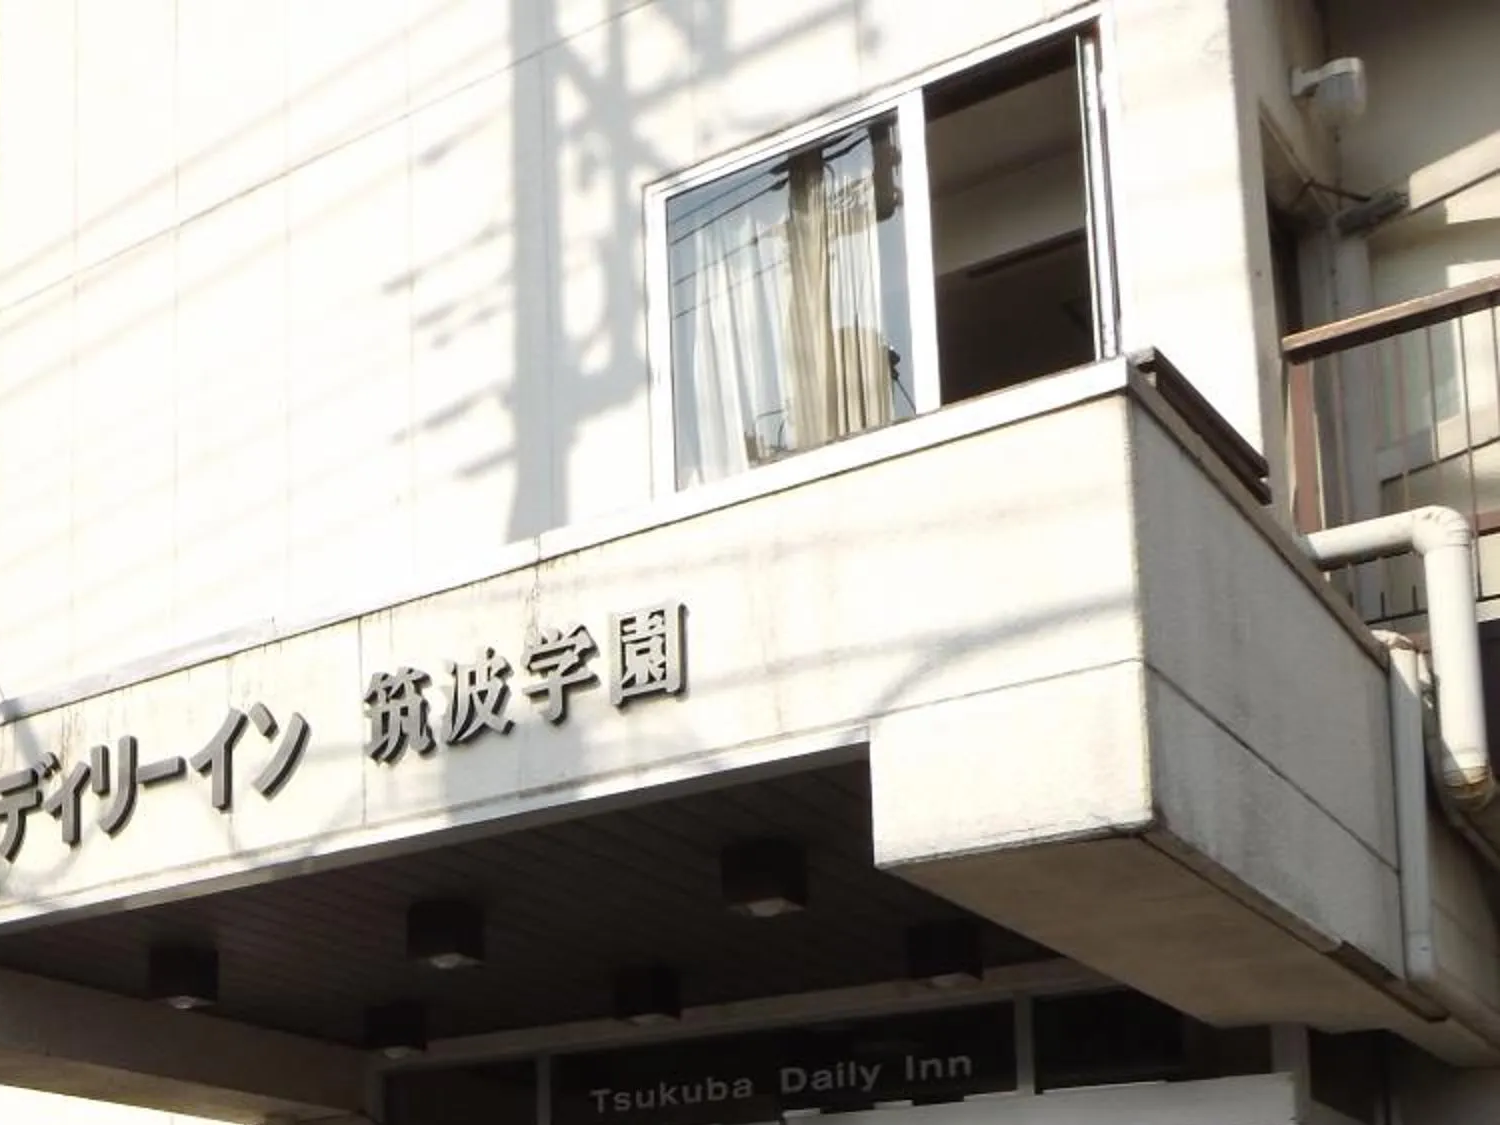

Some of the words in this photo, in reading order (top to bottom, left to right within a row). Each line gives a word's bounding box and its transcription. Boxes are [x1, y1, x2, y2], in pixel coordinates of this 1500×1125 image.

[363, 600, 689, 765] 筑波学園
[590, 1076, 754, 1114] Tsukuba
[780, 1060, 884, 1094] Daily
[905, 1053, 972, 1082] Inn
